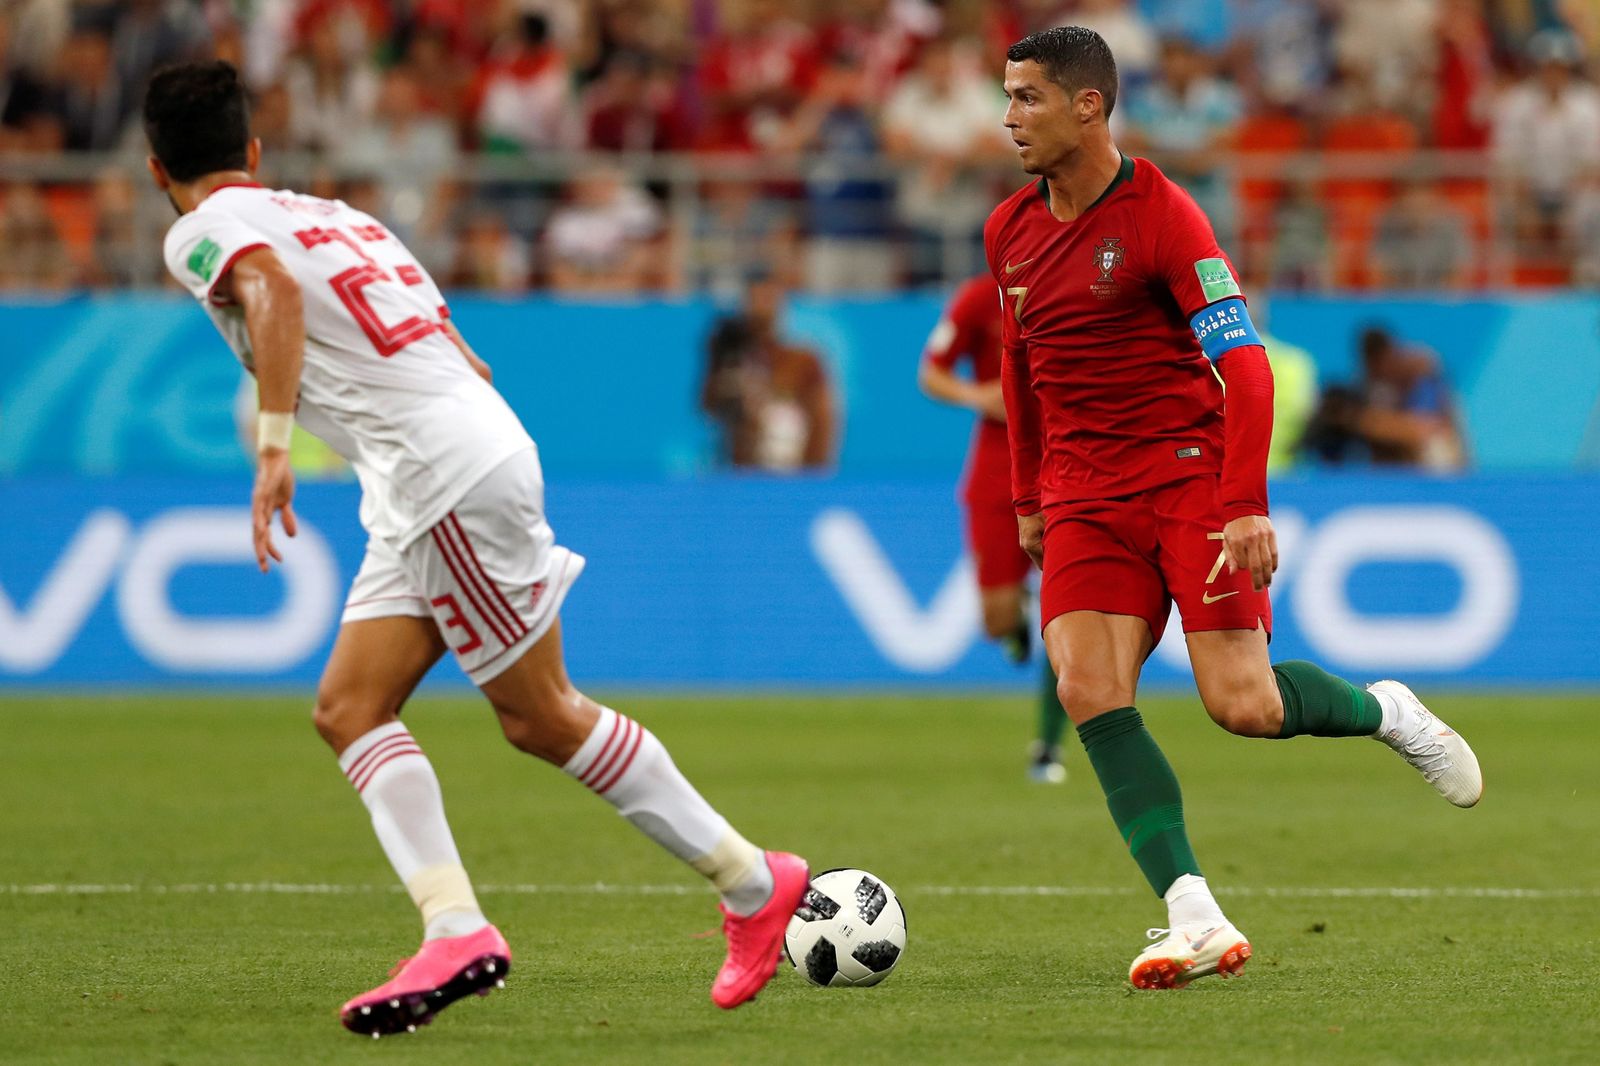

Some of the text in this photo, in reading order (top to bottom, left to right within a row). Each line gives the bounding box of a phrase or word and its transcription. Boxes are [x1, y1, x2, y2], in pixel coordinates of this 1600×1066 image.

[1006, 286, 1028, 329] 7
[1195, 306, 1238, 334] IVING
[1197, 315, 1241, 341] OTBALL
[1223, 328, 1247, 341] FIFA
[1205, 532, 1227, 584] 7
[431, 593, 483, 655] 3
